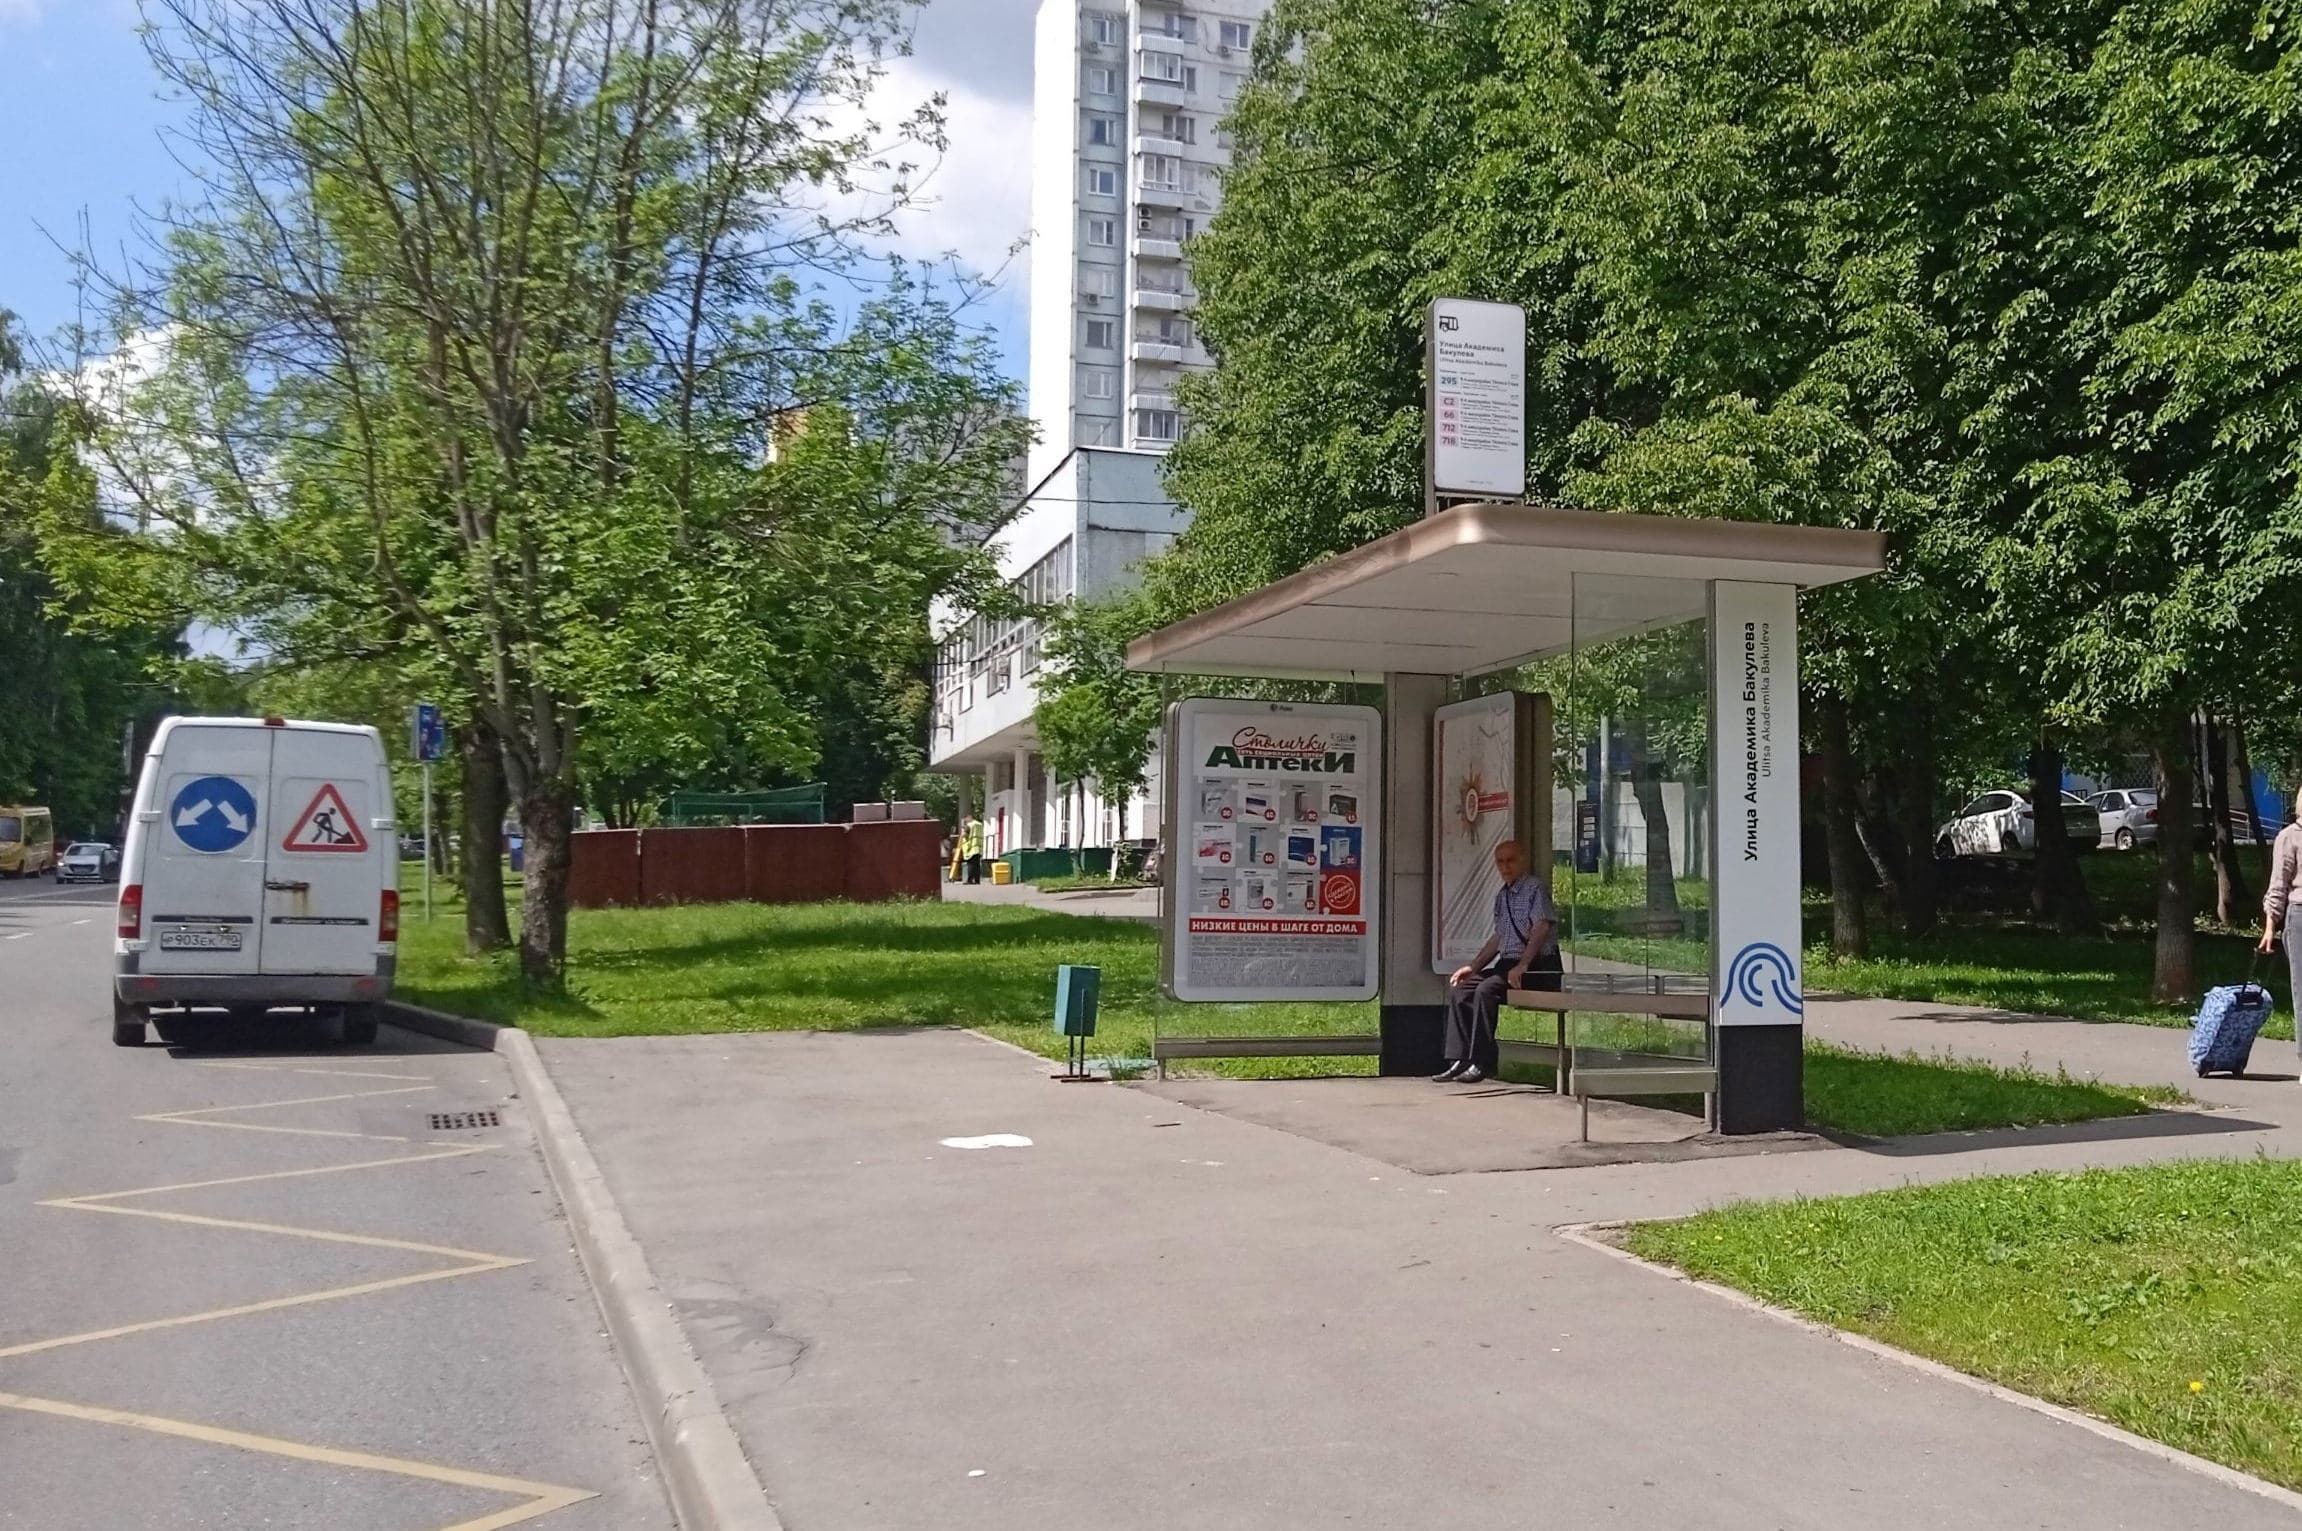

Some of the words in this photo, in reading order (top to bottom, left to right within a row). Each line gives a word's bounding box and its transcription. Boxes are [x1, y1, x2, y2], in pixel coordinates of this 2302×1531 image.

[1743, 622, 1758, 701] Бакулева
[1760, 623, 1770, 674] Bakuleva
[1760, 677, 1771, 742] Akademika
[1232, 726, 1329, 751] Столички
[1744, 706, 1759, 804] Академика
[1761, 745, 1771, 777] Ulitsa
[1744, 809, 1759, 861] Улица
[1191, 921, 1236, 931] НИЗКИЕ
[1238, 921, 1269, 932] ЦЕНЫ
[1271, 922, 1279, 931] В
[1281, 922, 1309, 932] ШАГЕ
[1311, 922, 1324, 932] ОТ
[1326, 922, 1358, 934] ДОМА
